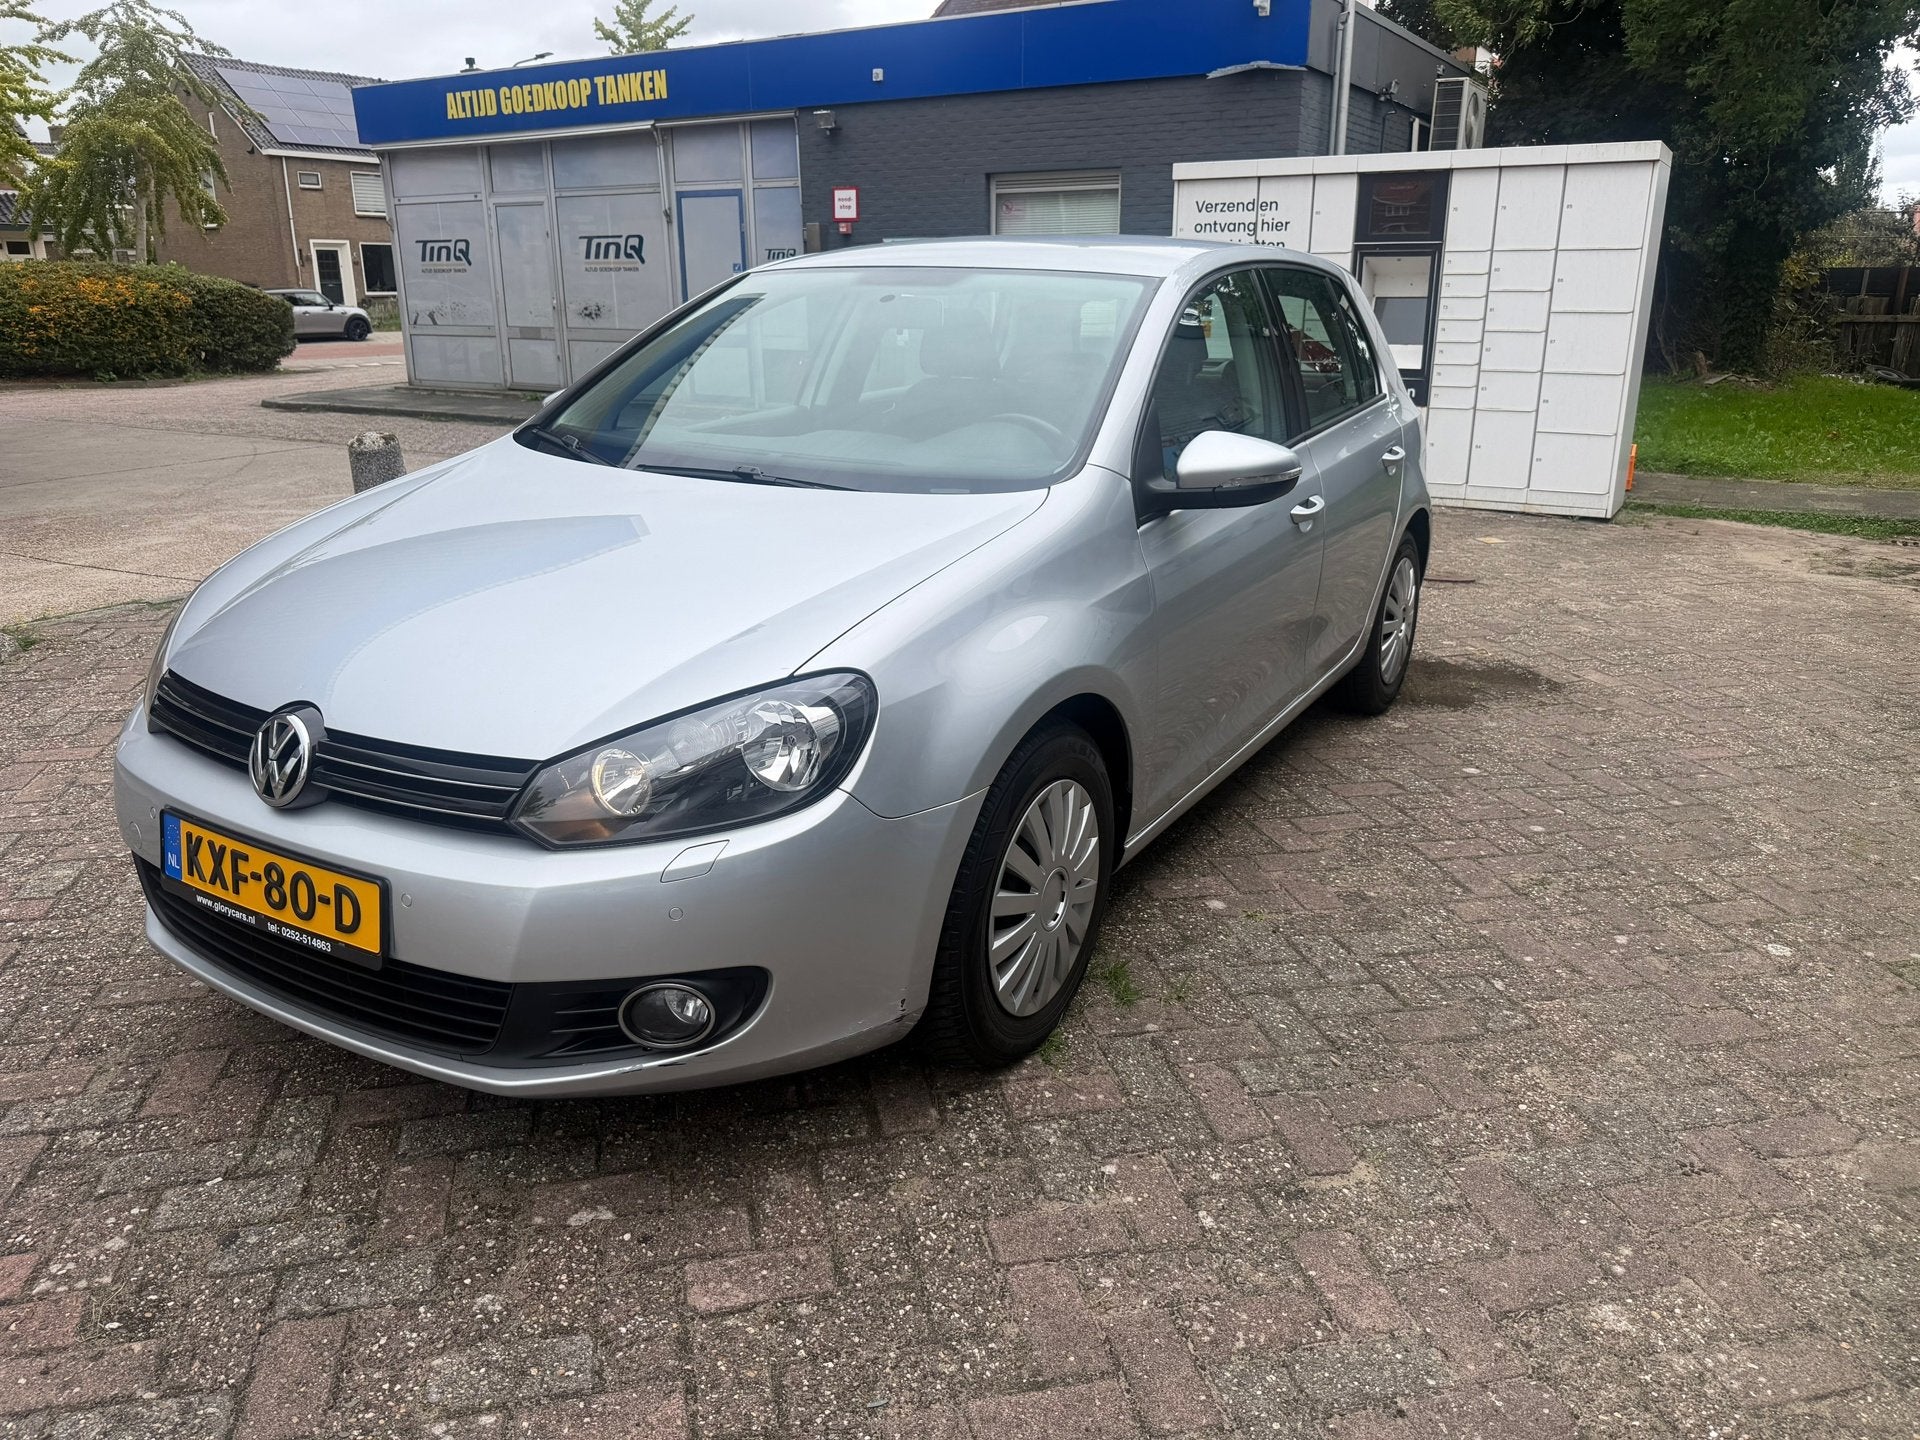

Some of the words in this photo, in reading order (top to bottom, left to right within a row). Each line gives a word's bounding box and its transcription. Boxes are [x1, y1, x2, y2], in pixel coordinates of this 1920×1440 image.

[446, 89, 497, 119] ALTIJD
[500, 78, 592, 115] GOEDKOOP
[594, 69, 668, 105] TANKEN
[1196, 199, 1256, 213] Verzend
[1260, 200, 1278, 212] en
[1194, 219, 1256, 236] ontvang
[1261, 218, 1291, 232] hier
[415, 239, 472, 266] TinQ
[579, 234, 645, 264] TinQ
[168, 851, 180, 869] NL
[186, 831, 361, 934] KXF-80-D
[196, 894, 256, 925] www.glorycars.nl
[267, 921, 280, 934] tel:
[281, 926, 331, 952] 0252-514863
